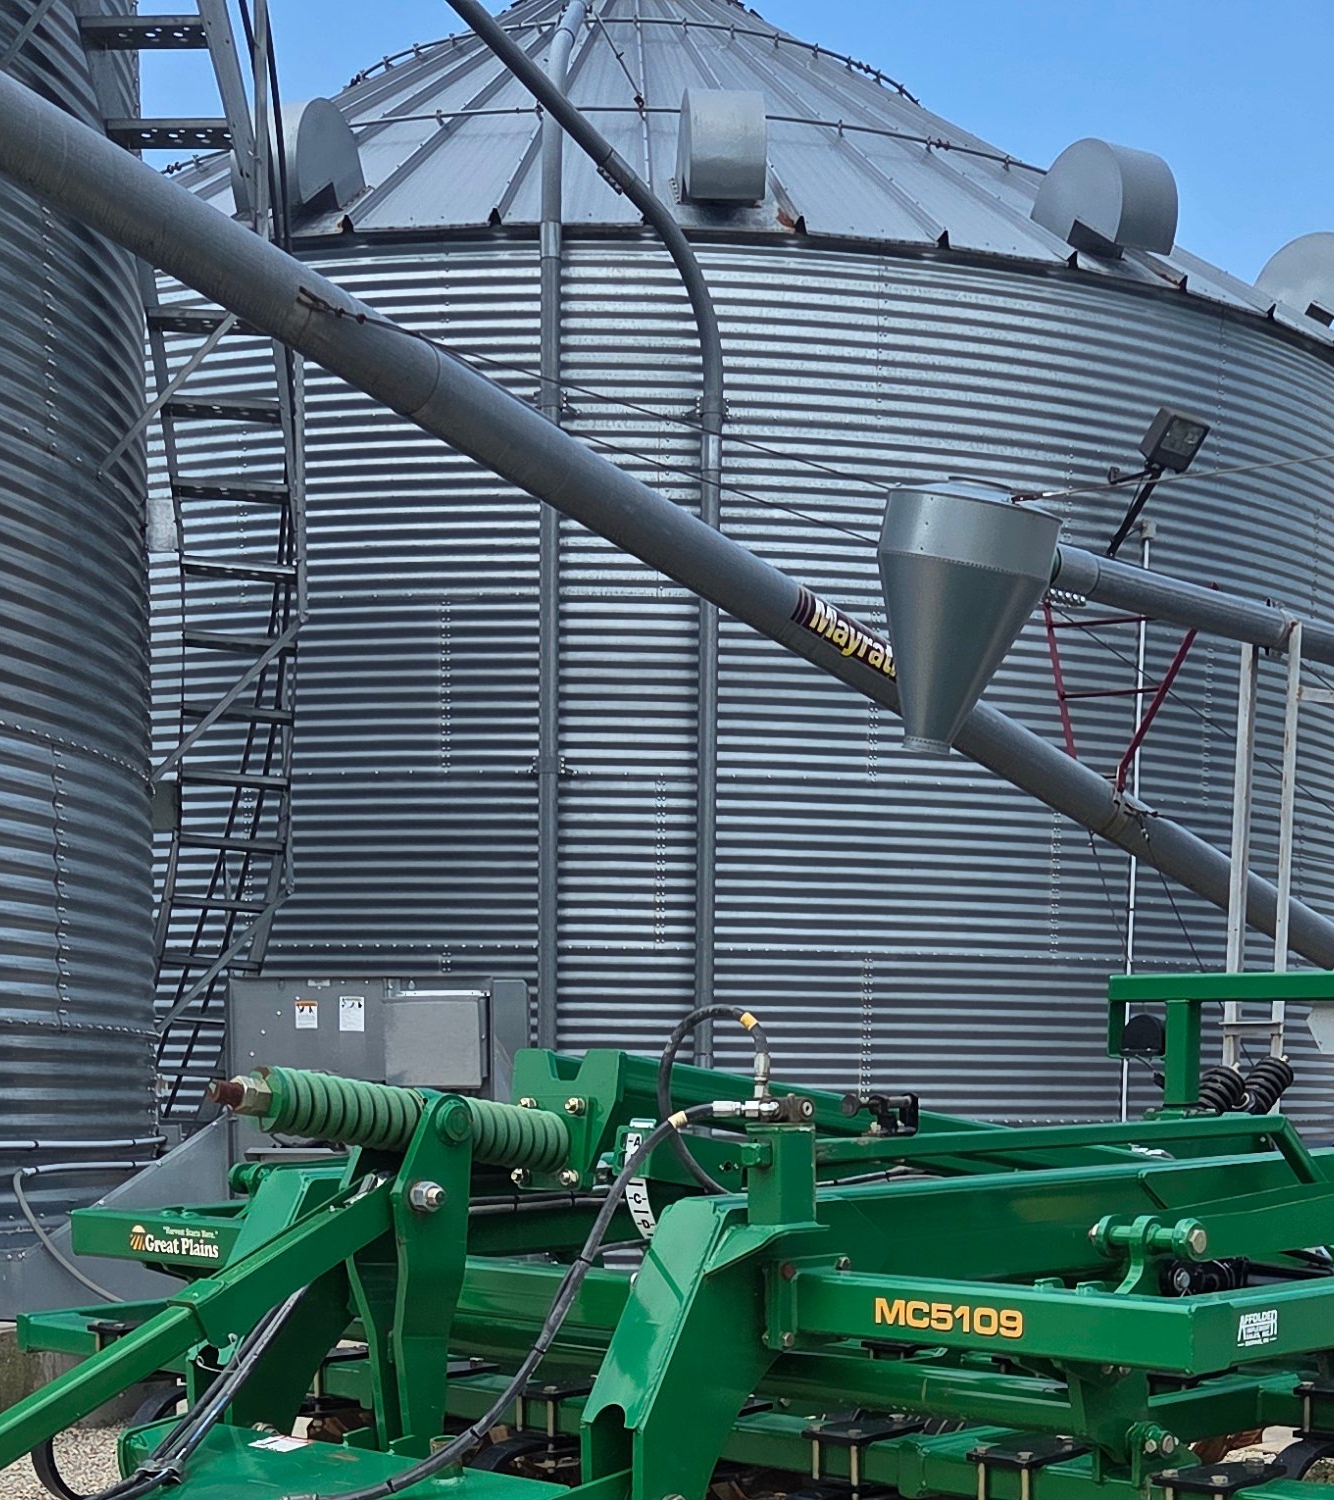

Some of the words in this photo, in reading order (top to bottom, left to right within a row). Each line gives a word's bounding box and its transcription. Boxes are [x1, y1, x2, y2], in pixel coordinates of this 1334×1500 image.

[809, 598, 896, 677] Mayrat
[145, 1234, 180, 1254] Great
[180, 1237, 219, 1258] Plains
[875, 1297, 1023, 1338] MC5109
